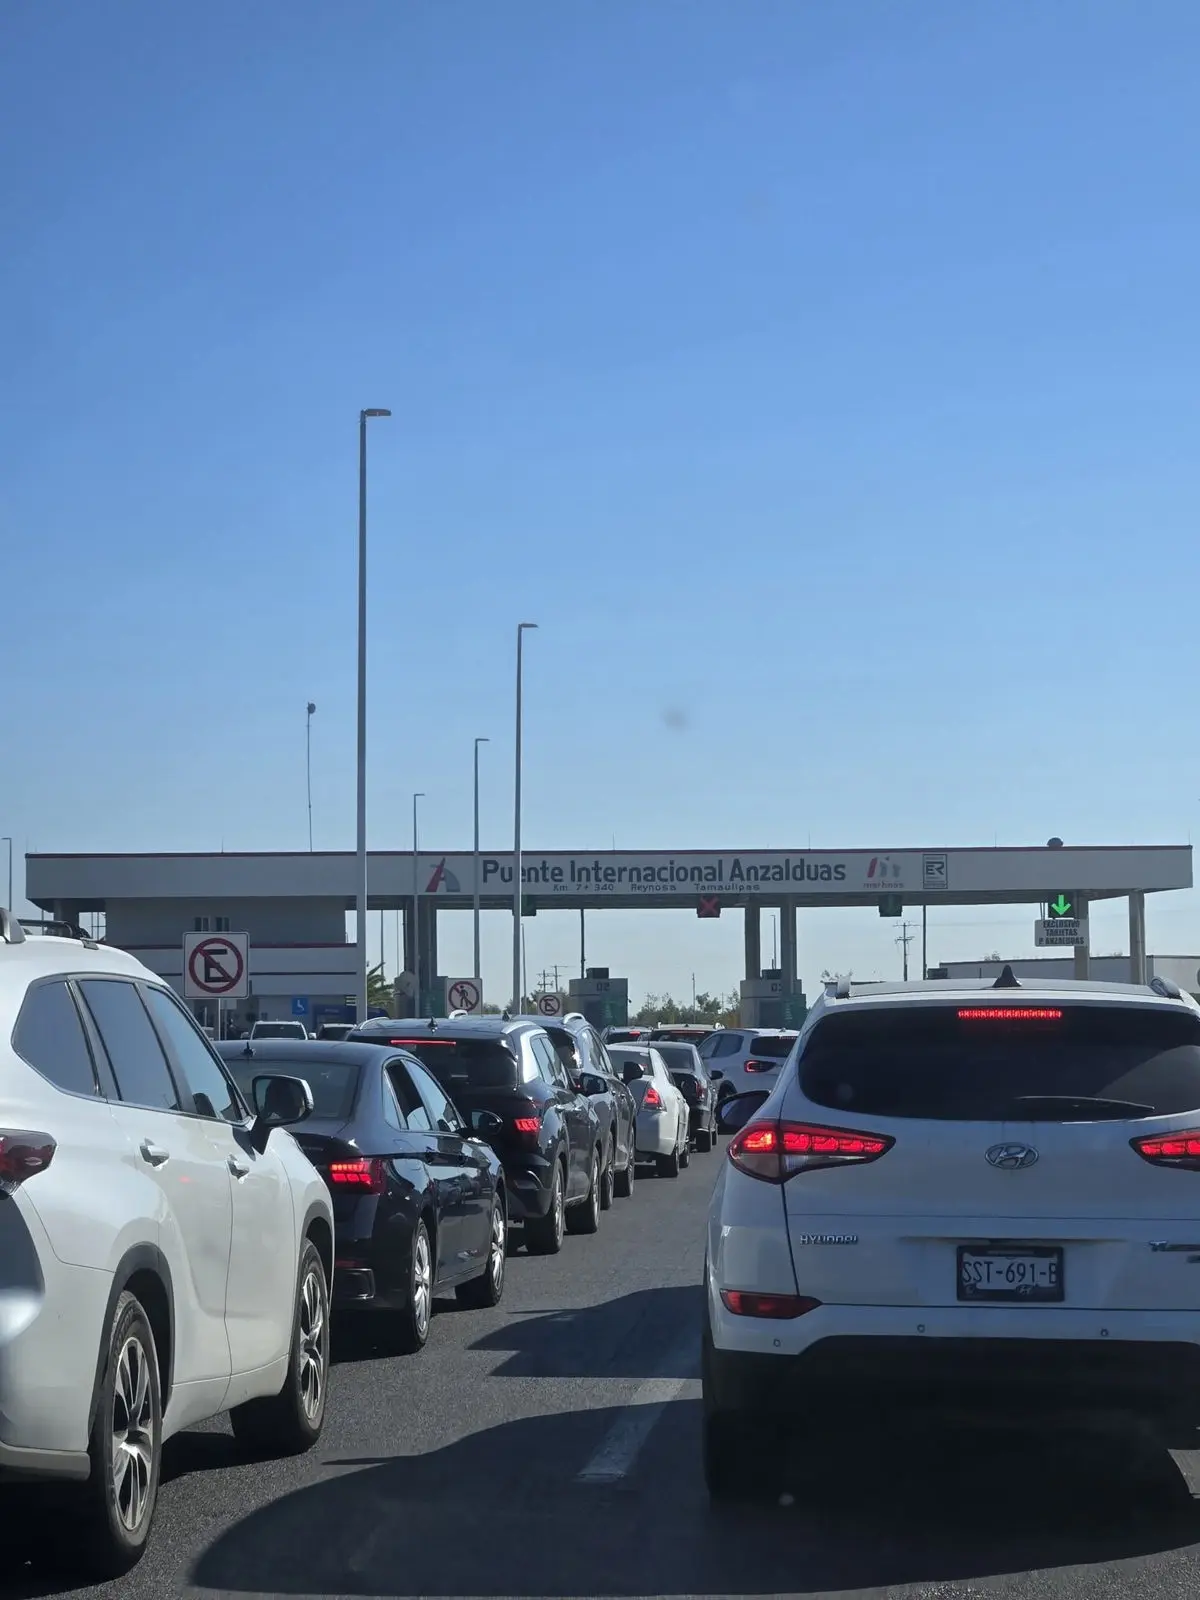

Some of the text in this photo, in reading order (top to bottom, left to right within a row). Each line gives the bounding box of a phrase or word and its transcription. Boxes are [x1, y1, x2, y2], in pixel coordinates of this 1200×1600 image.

[570, 859, 723, 883] Internacional
[729, 858, 846, 882] Anzalduas
[631, 883, 676, 893] Reynosa
[694, 883, 760, 893] Tamaulipas
[799, 1234, 858, 1245] HYUNDAI
